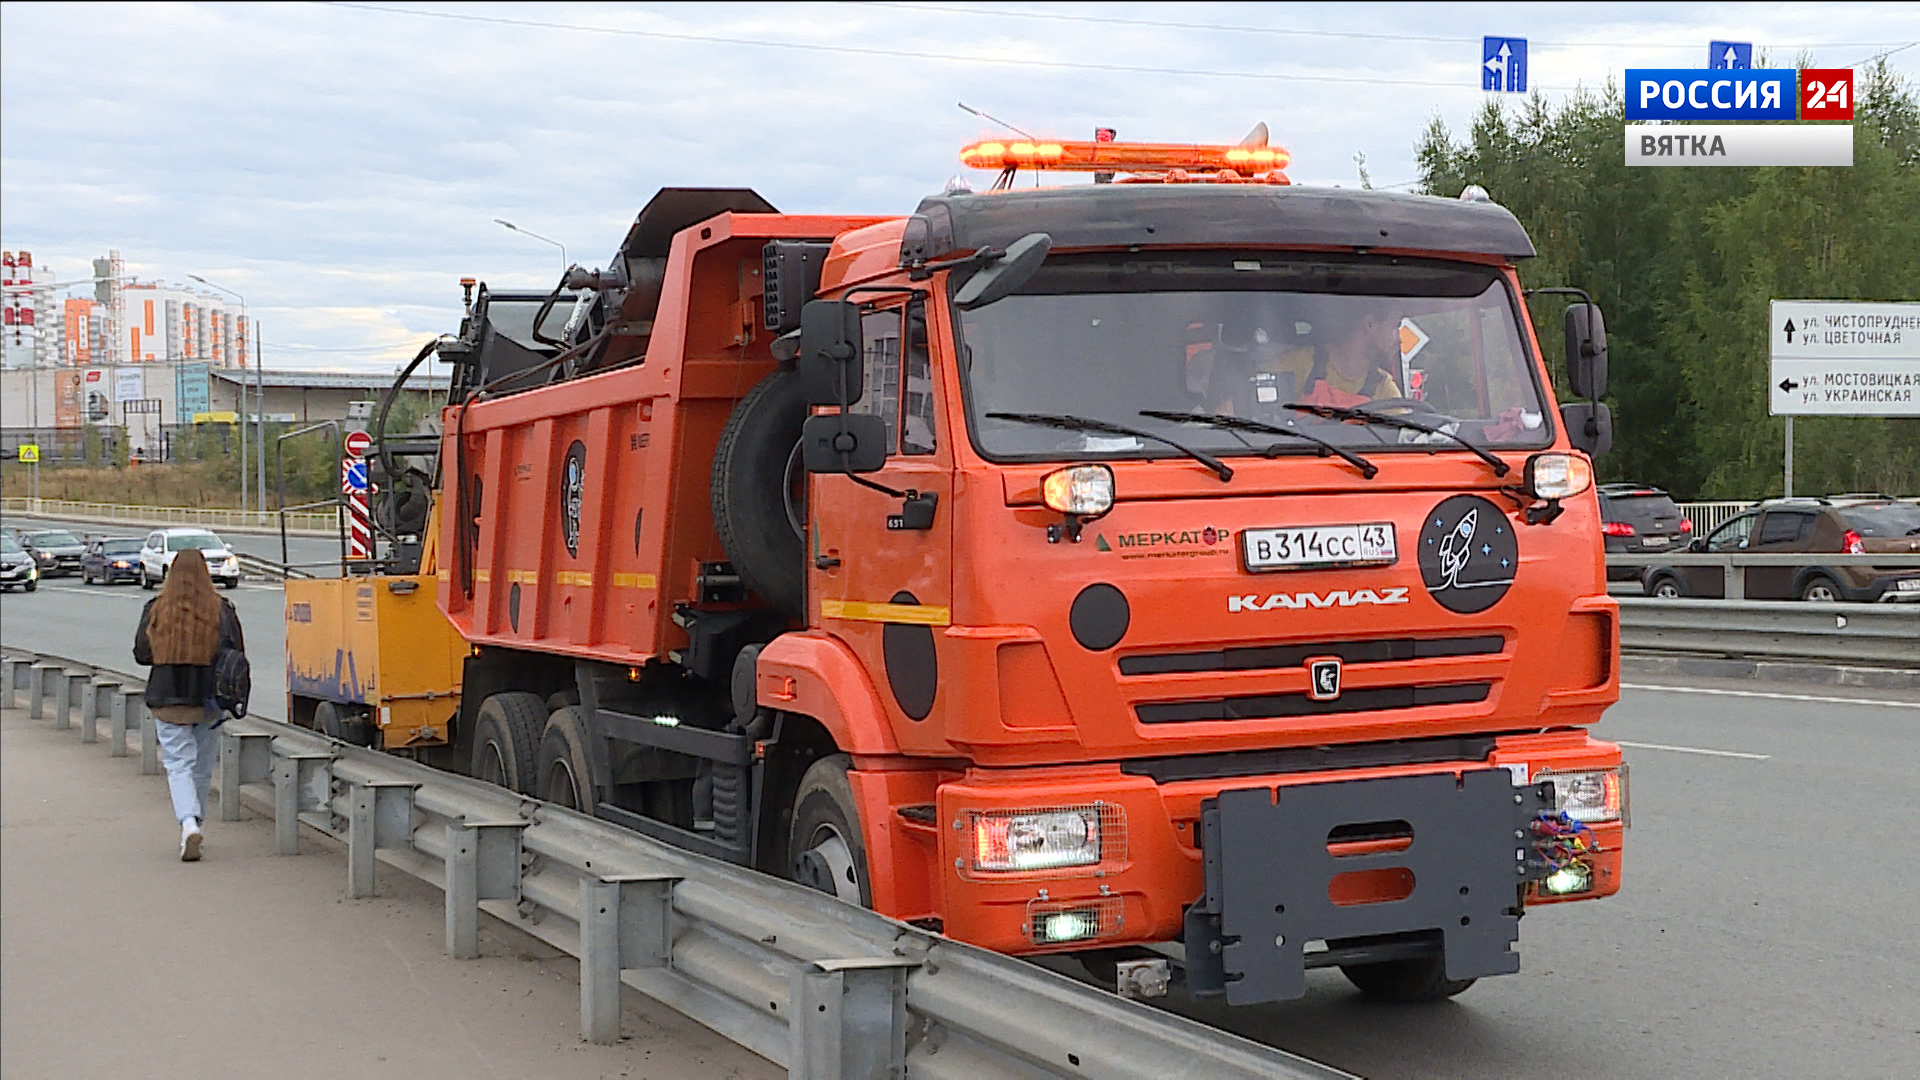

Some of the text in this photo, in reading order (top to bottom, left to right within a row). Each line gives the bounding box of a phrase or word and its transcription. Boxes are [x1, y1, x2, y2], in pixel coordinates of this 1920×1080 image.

[1803, 317, 1819, 330] ул.
[1803, 331, 1901, 346] ул. ЦВЕТОЧНАЯ
[1803, 373, 1920, 388] ул. МОСТОВИЦКАЯ
[1803, 389, 1911, 405] ул. УКРАИНСКАЯ
[1118, 526, 1230, 548] МЕРКАТОР
[1257, 527, 1386, 560] В314СС 43
[1228, 587, 1410, 613] KAMAZ
